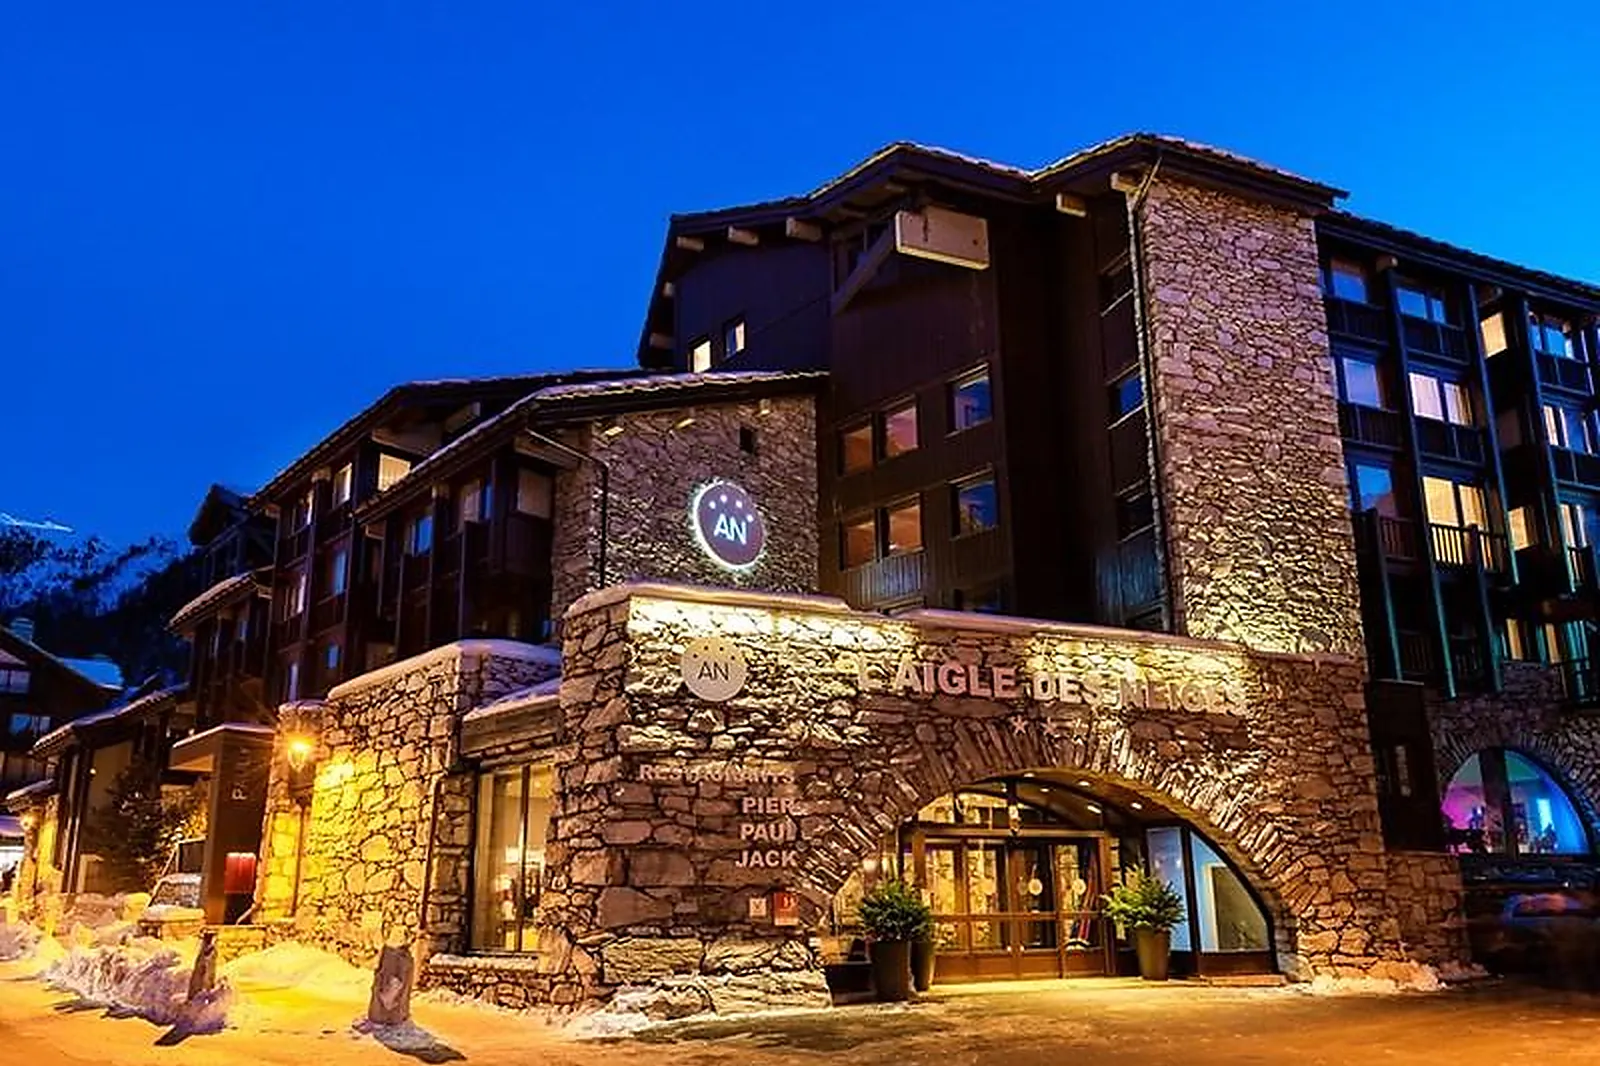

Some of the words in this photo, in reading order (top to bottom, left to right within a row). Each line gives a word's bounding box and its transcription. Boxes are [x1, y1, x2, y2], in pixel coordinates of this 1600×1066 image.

[713, 513, 747, 545] AN
[698, 661, 729, 682] AN
[1033, 670, 1104, 709] DES
[741, 796, 796, 814] PIER
[740, 822, 799, 841] PAUL
[735, 849, 799, 868] JACK
